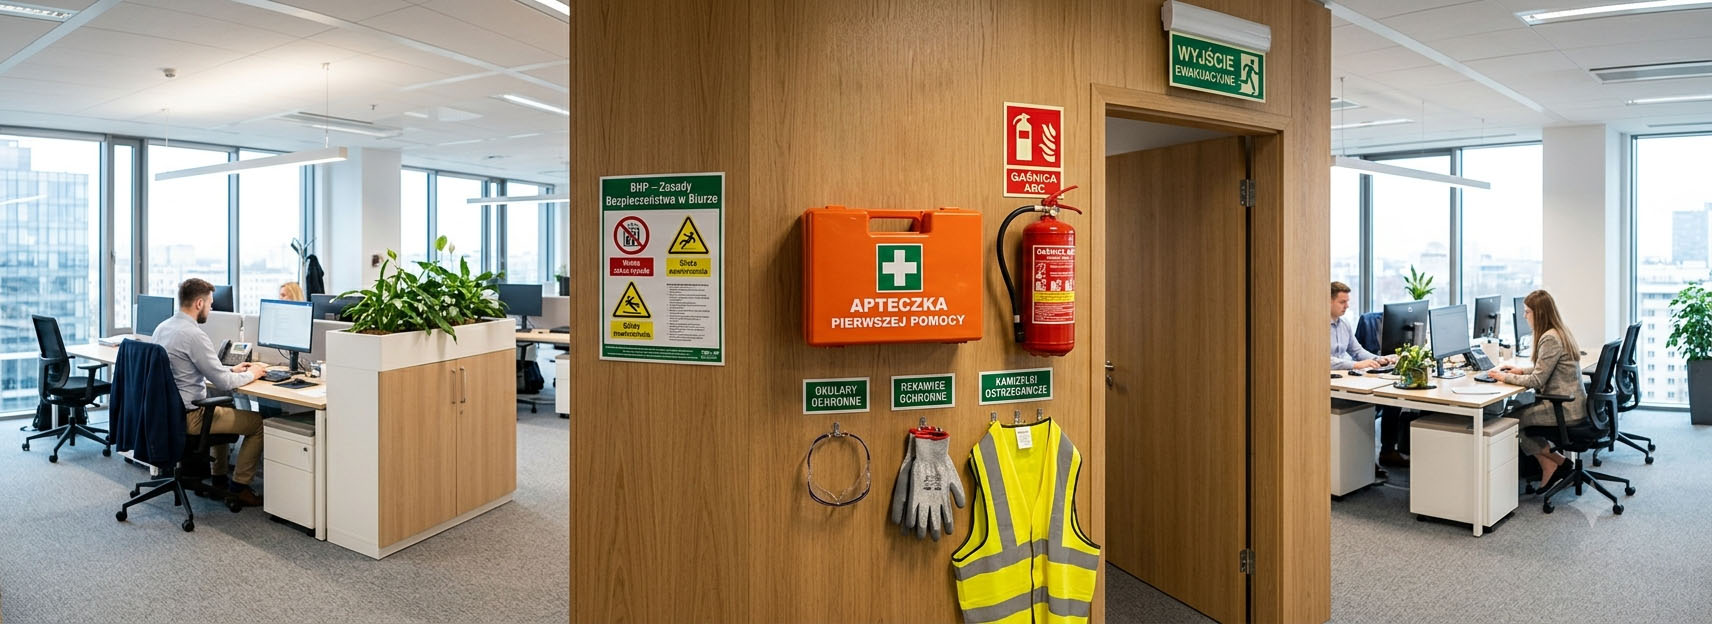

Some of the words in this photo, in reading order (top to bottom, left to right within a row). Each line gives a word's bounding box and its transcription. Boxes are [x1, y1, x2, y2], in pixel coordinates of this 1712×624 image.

[1177, 45, 1234, 70] WYJŚCIE
[1175, 65, 1235, 86] EWAKUACYJNE
[1010, 172, 1057, 183] GAŚNICA
[630, 182, 649, 193] BHP
[659, 181, 692, 193] Zasady
[606, 195, 676, 207] Bezpieczeństwa
[678, 195, 687, 205] w
[688, 193, 718, 204] Biurze
[850, 297, 948, 312] APTECZKA
[831, 317, 907, 329] PIERWSZEJ
[910, 315, 966, 327] POMOCY
[815, 385, 858, 396] OKULARY
